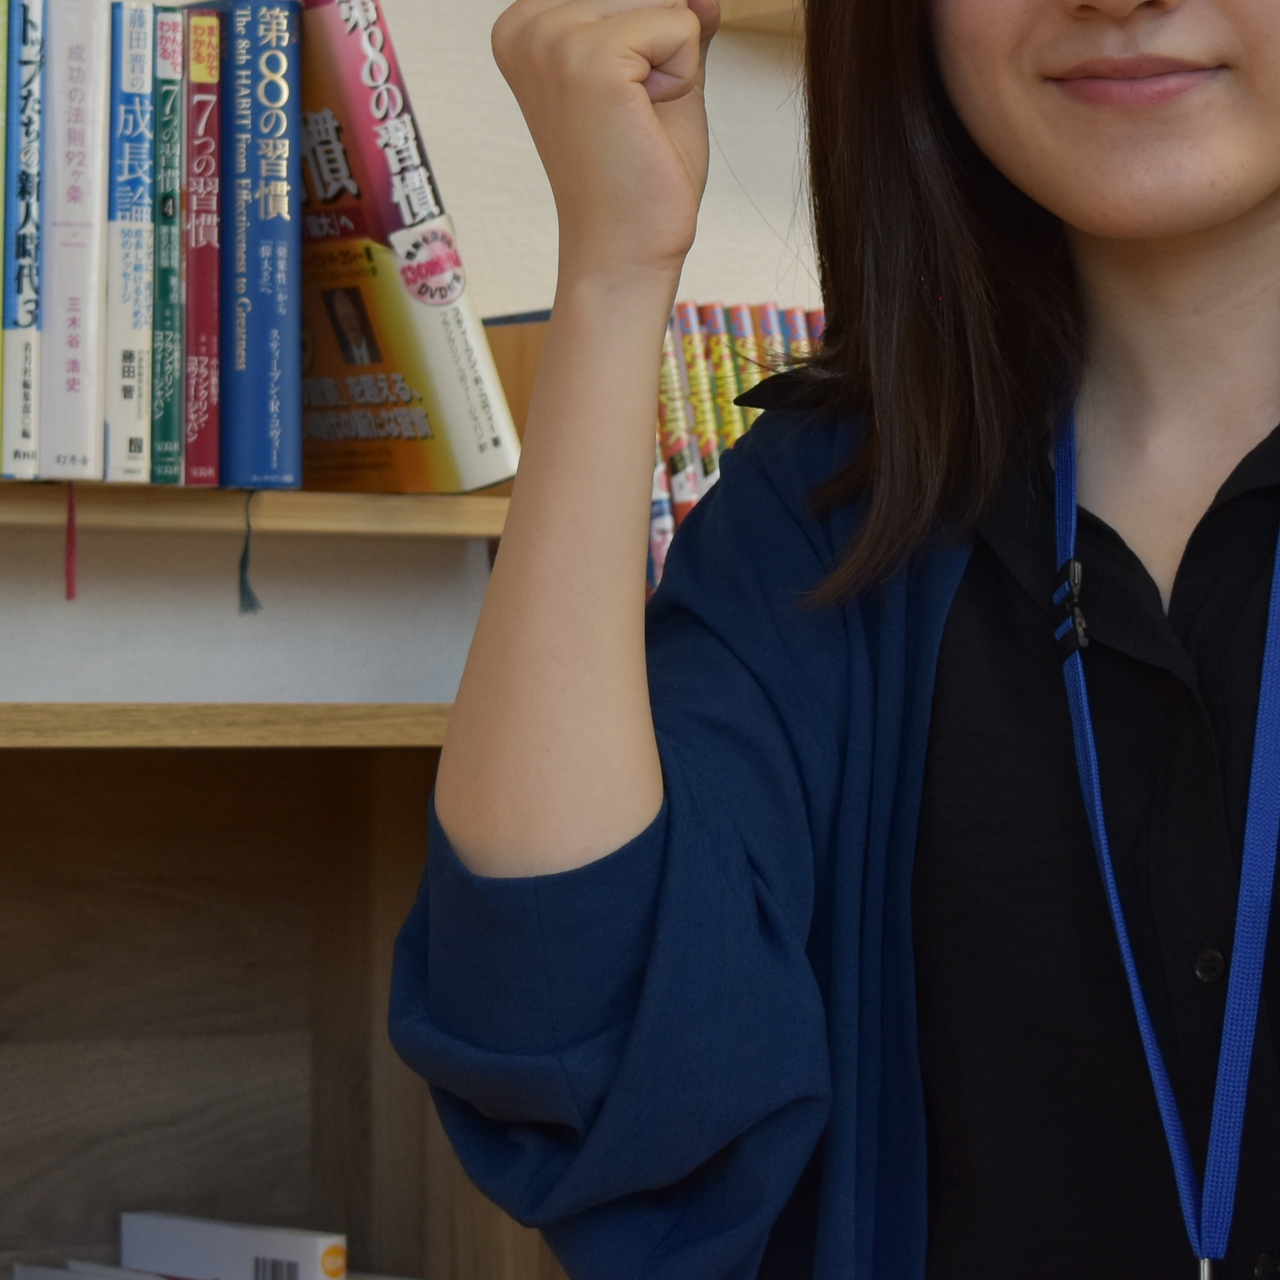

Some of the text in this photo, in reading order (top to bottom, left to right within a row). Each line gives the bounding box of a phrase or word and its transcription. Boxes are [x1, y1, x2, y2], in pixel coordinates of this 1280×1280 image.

[158, 19, 171, 61] わかる
[192, 23, 206, 65] わかる
[206, 23, 219, 79] まんがで
[114, 96, 155, 223] 成長論
[156, 84, 181, 194] 7つの習慣
[255, 6, 293, 223] 第8の習慣
[186, 93, 221, 249] 7つの習慣
[235, 6, 252, 372] The 8th HABIT From Effectiveness to Greatness
[65, 296, 82, 394] 三木谷 浩史
[121, 349, 136, 380] 藤田
